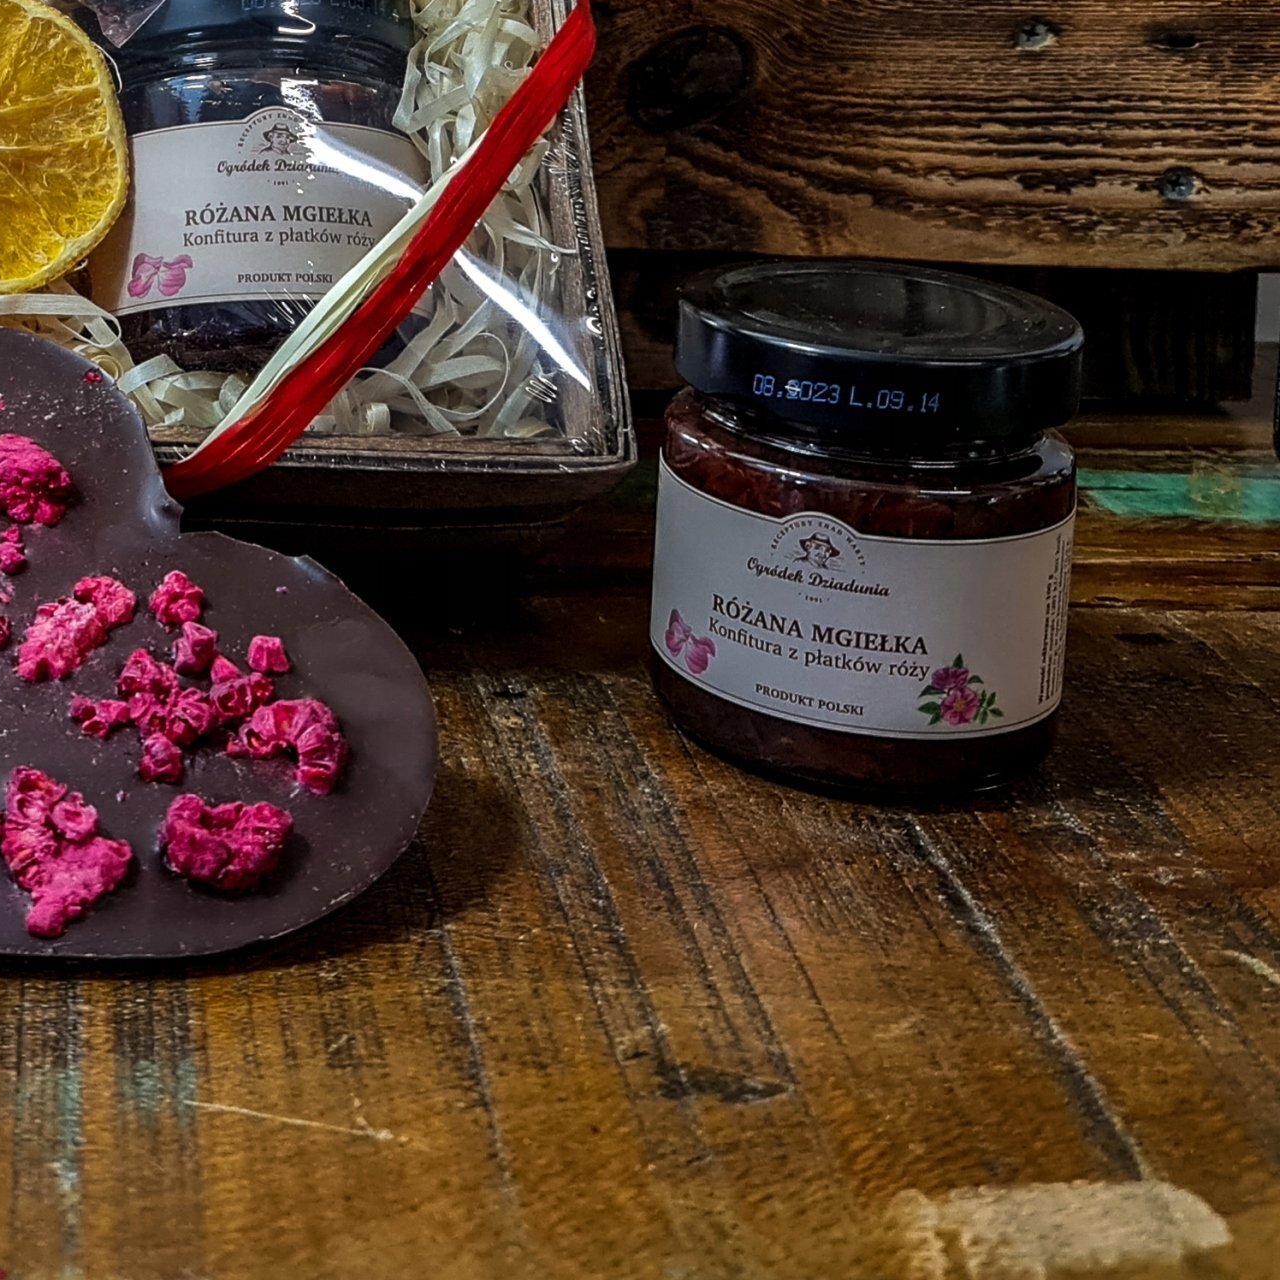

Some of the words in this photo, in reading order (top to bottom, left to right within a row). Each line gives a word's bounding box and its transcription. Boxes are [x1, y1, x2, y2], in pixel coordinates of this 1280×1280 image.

[216, 159, 271, 177] Ogródek
[184, 202, 276, 227] RÓŻANA
[282, 204, 374, 228] MGIEŁKA
[183, 228, 259, 247] Konfitura
[264, 230, 274, 243] z
[279, 227, 342, 246] płatków
[346, 231, 376, 248] róży
[237, 272, 293, 284] PRODUKT
[295, 272, 333, 284] POLSKI
[752, 373, 841, 404] 08.2023
[849, 385, 940, 413] L.09.14
[746, 556, 805, 584] Ogródek
[807, 571, 891, 597] Dziadunia
[711, 593, 804, 639] RÓŻANA
[812, 623, 929, 655] MGIEŁKA
[708, 617, 783, 657] Konfitura
[788, 646, 799, 660] z
[803, 648, 883, 675] płatków
[888, 660, 931, 682] róży
[755, 683, 815, 707] PRODUKT
[817, 698, 865, 716] POLSKI
